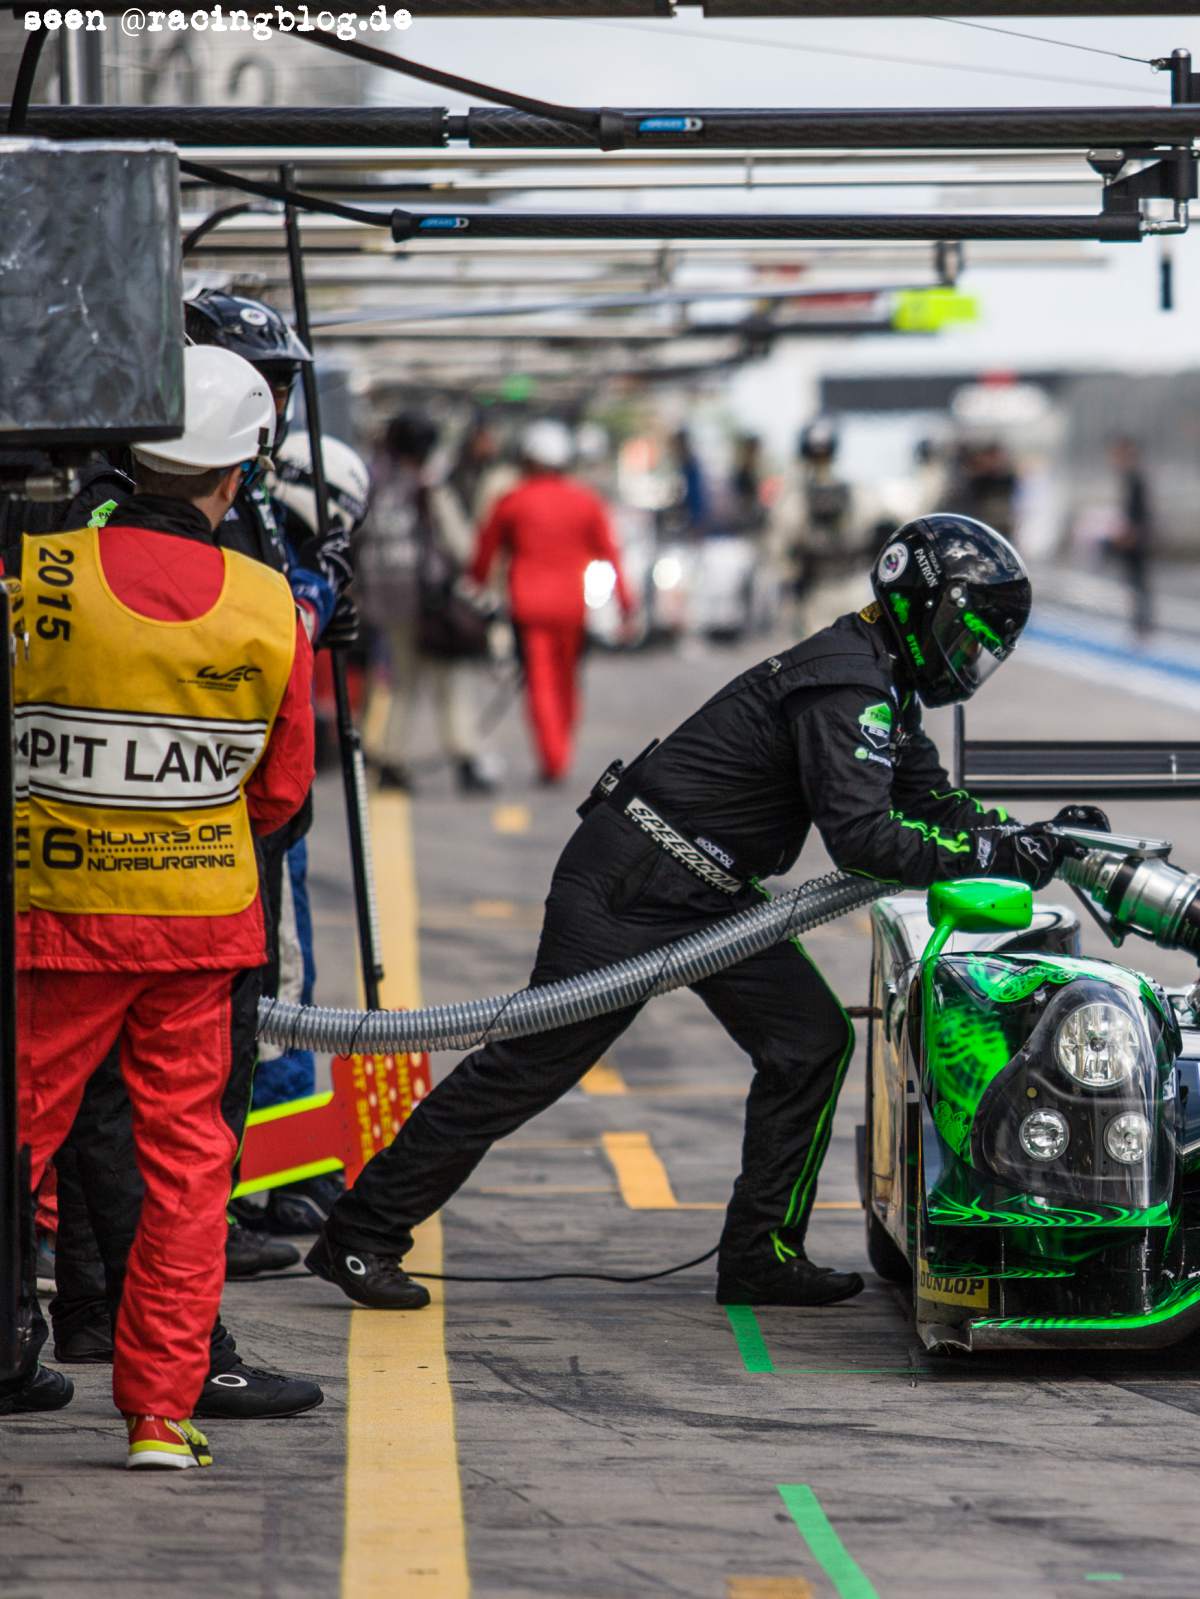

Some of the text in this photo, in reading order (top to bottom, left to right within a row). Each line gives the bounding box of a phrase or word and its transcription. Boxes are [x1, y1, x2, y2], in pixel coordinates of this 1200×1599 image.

[35, 547, 75, 642] 2015
[906, 633, 926, 667] STEVE
[29, 728, 255, 783] PIT LANE
[42, 827, 84, 870] 6
[198, 824, 233, 842] OF
[87, 853, 236, 872] NÜRBURGRING
